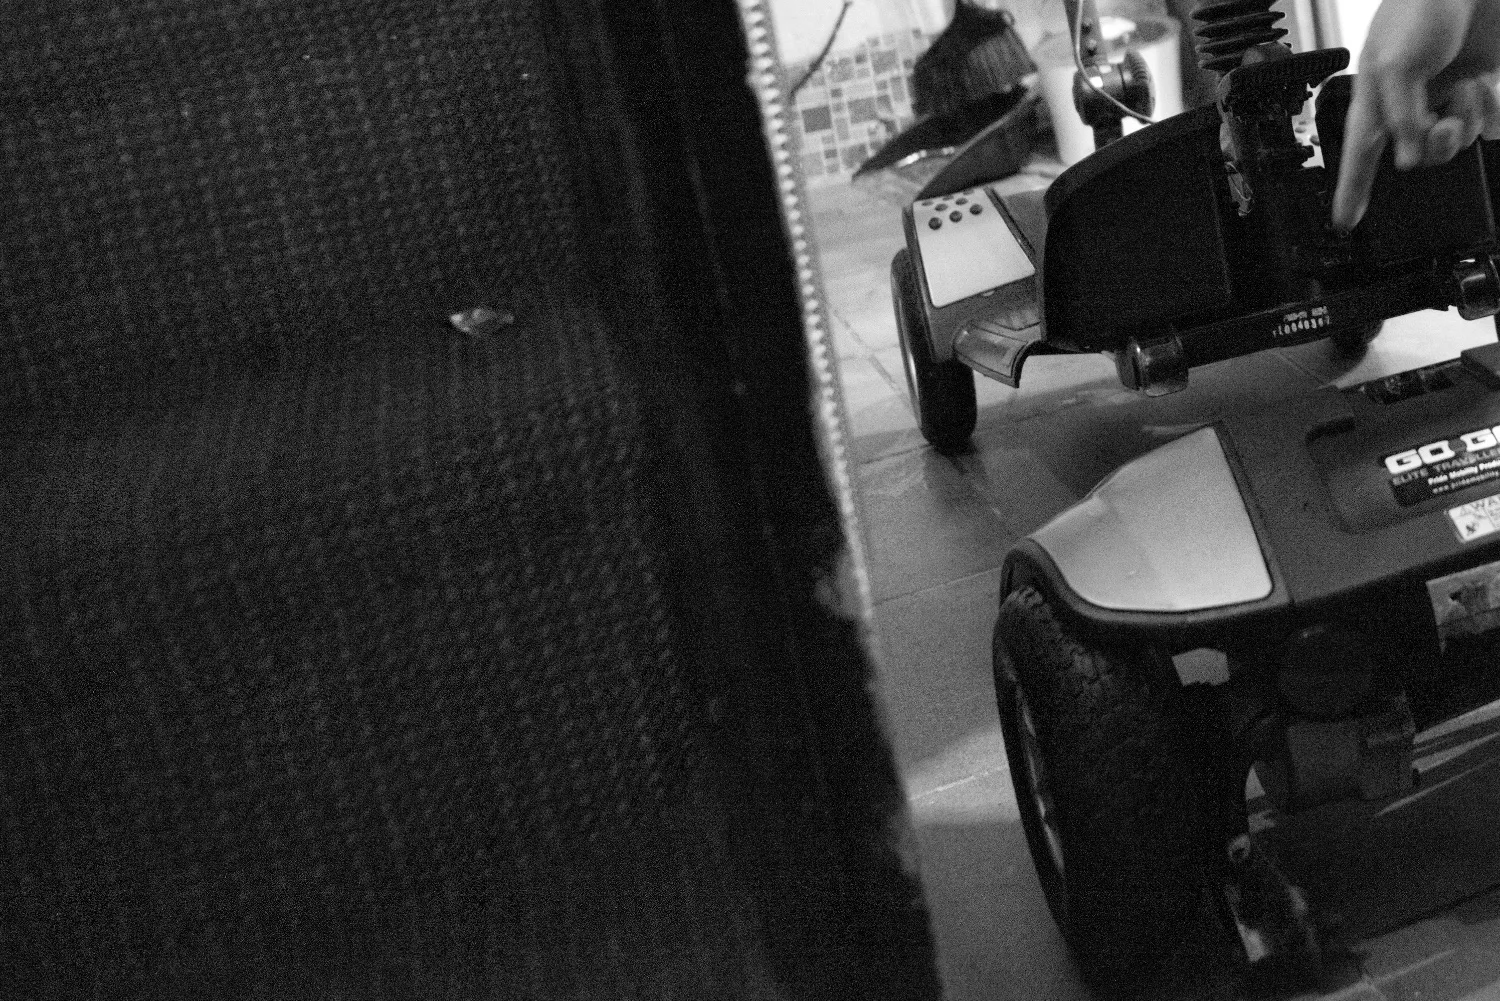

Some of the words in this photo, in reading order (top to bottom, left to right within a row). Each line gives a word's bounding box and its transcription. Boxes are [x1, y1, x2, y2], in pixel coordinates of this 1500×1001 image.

[1385, 440, 1455, 474] GO
[1428, 474, 1448, 485] Pride
[1449, 465, 1478, 479] Mobility
